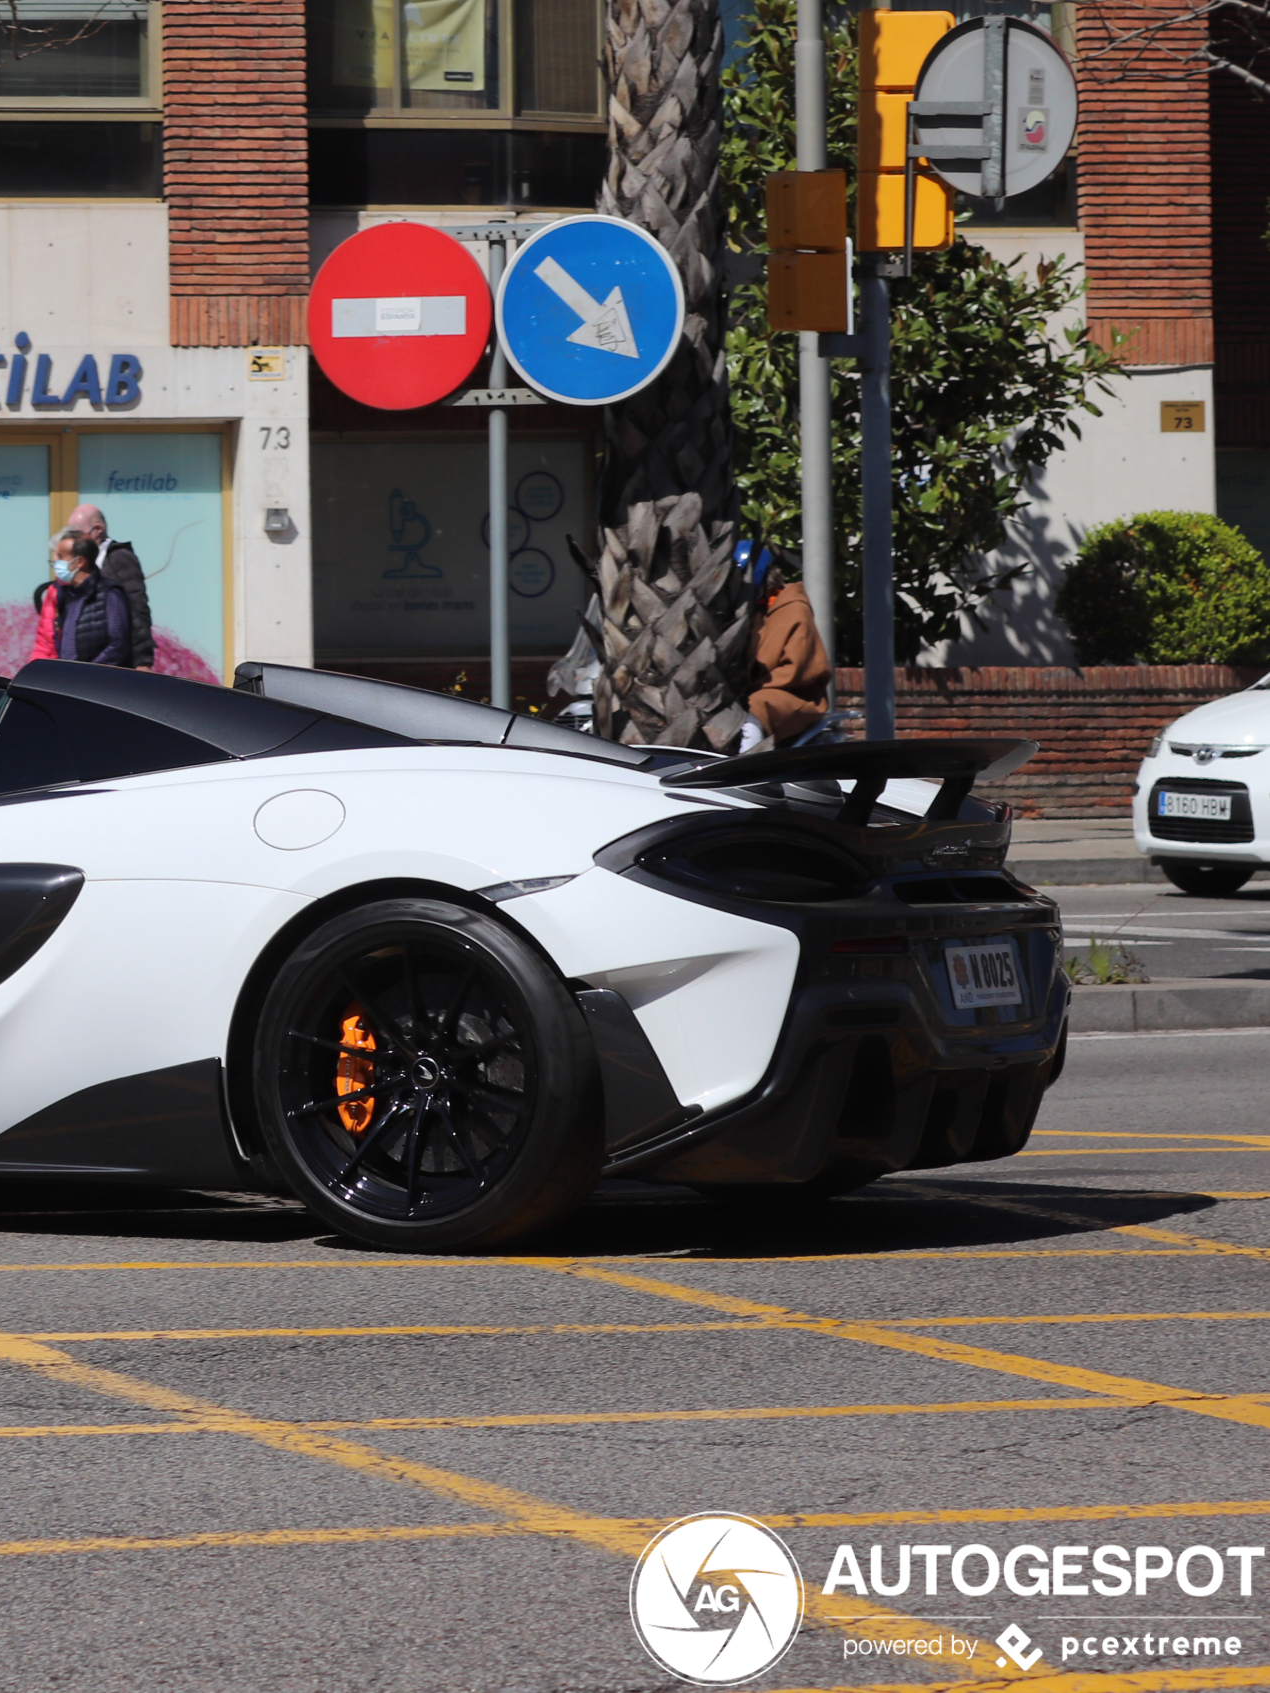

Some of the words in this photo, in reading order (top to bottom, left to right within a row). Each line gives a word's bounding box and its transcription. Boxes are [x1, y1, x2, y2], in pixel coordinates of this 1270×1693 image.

[1174, 416, 1194, 429] 73
[259, 426, 290, 450] 73
[105, 470, 178, 498] fertilab
[404, 600, 439, 611] bones
[441, 601, 475, 611] mans
[1167, 796, 1198, 814] 8160
[969, 953, 983, 989] N
[980, 951, 1014, 989] 8025
[960, 992, 974, 1004] AND
